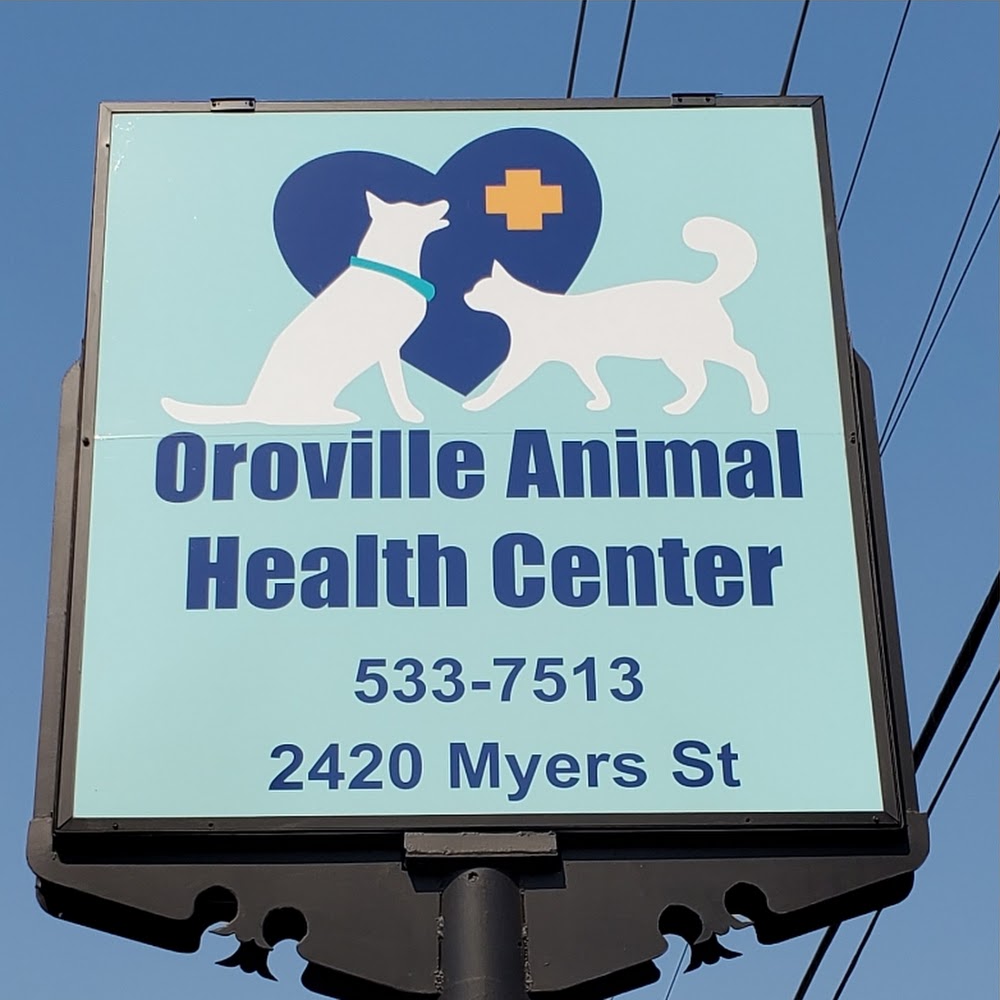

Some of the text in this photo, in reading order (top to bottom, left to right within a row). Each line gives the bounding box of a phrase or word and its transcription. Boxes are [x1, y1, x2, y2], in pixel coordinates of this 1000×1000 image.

[155, 428, 804, 504] Oroville Animal
[185, 532, 784, 611] Health Center
[354, 656, 644, 704] 533-7513
[268, 739, 742, 802] 2420 Myers St
